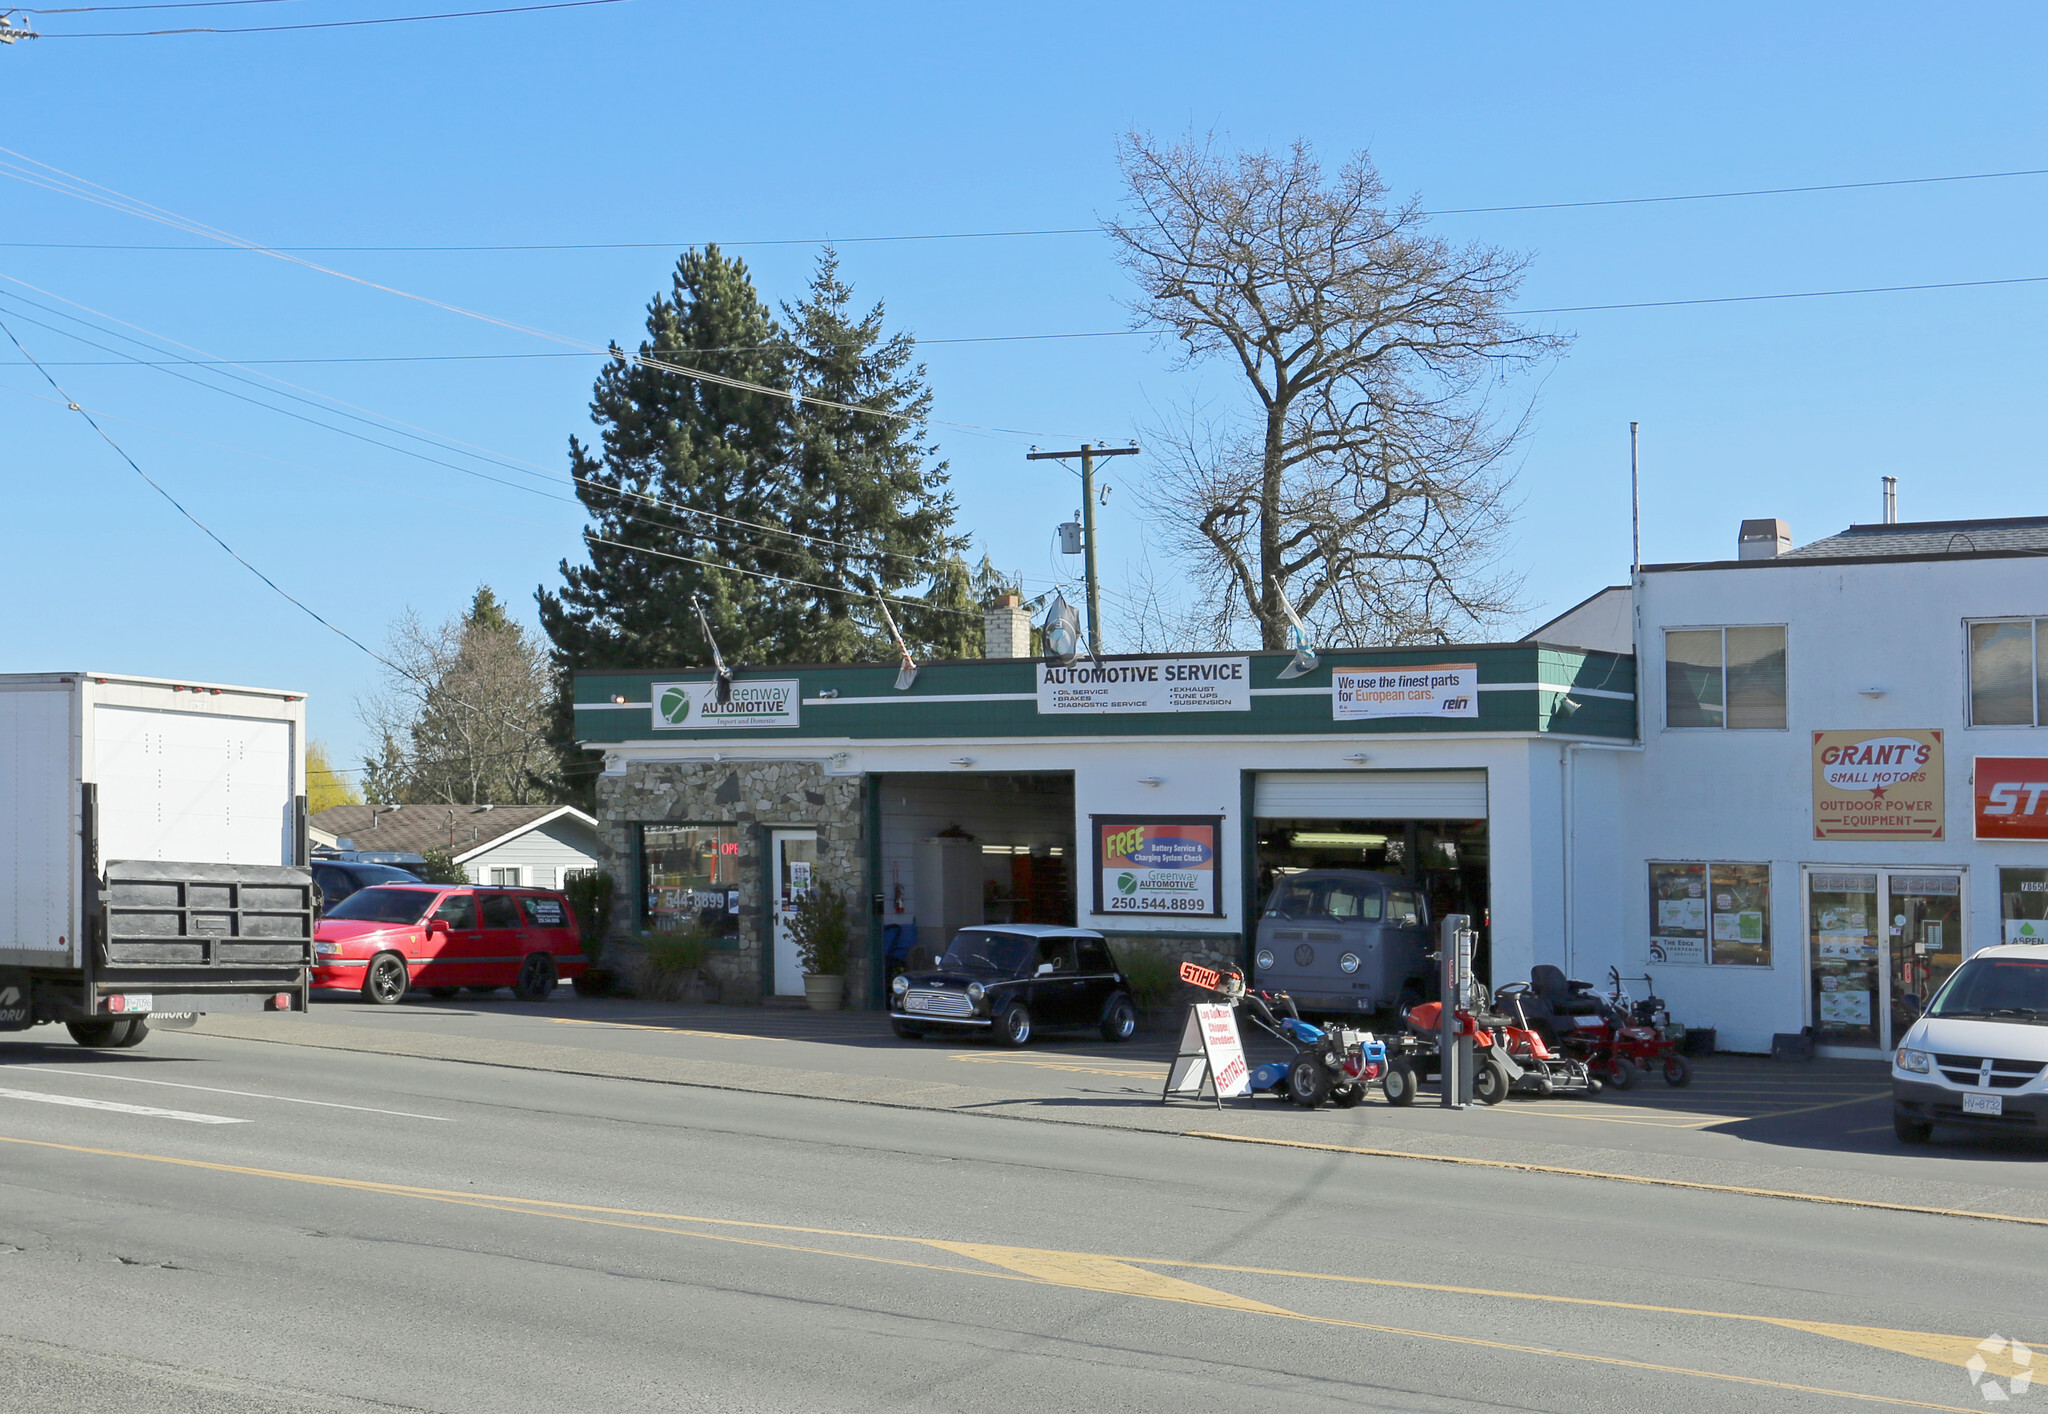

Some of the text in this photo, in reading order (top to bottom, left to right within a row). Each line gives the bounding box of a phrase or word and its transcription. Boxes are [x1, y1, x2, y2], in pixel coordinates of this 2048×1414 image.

[1044, 664, 1243, 684] AUTOMOTIVE SERVICE
[1338, 674, 1460, 689] We use the finest parts
[1338, 689, 1435, 703] for European cars.
[701, 700, 784, 714] AUTOMOTIVE
[1442, 697, 1468, 710] rein
[717, 718, 738, 726] Import
[1821, 744, 1931, 765] GRANT'S
[1830, 772, 1926, 782] SMALL MOTORS
[1983, 782, 2048, 815] ST
[1820, 800, 1932, 811] OUTDOOR POWER
[1843, 815, 1912, 826] EQUIPMENT
[721, 843, 738, 855] OPE
[1106, 826, 1145, 860] FREE
[1151, 844, 1173, 853] Battery
[1174, 844, 1195, 852] Service
[1134, 854, 1203, 862] Charging System Check
[1148, 870, 1199, 882] Greenway
[1140, 880, 1195, 888] AUTOMOTIVE
[2022, 882, 2043, 892] 7865
[1111, 897, 1205, 911] 250.544.8899
[1181, 965, 1218, 988] STIHL
[1209, 1036, 1235, 1046] Shredders
[1216, 1055, 1246, 1093] RENTALS
